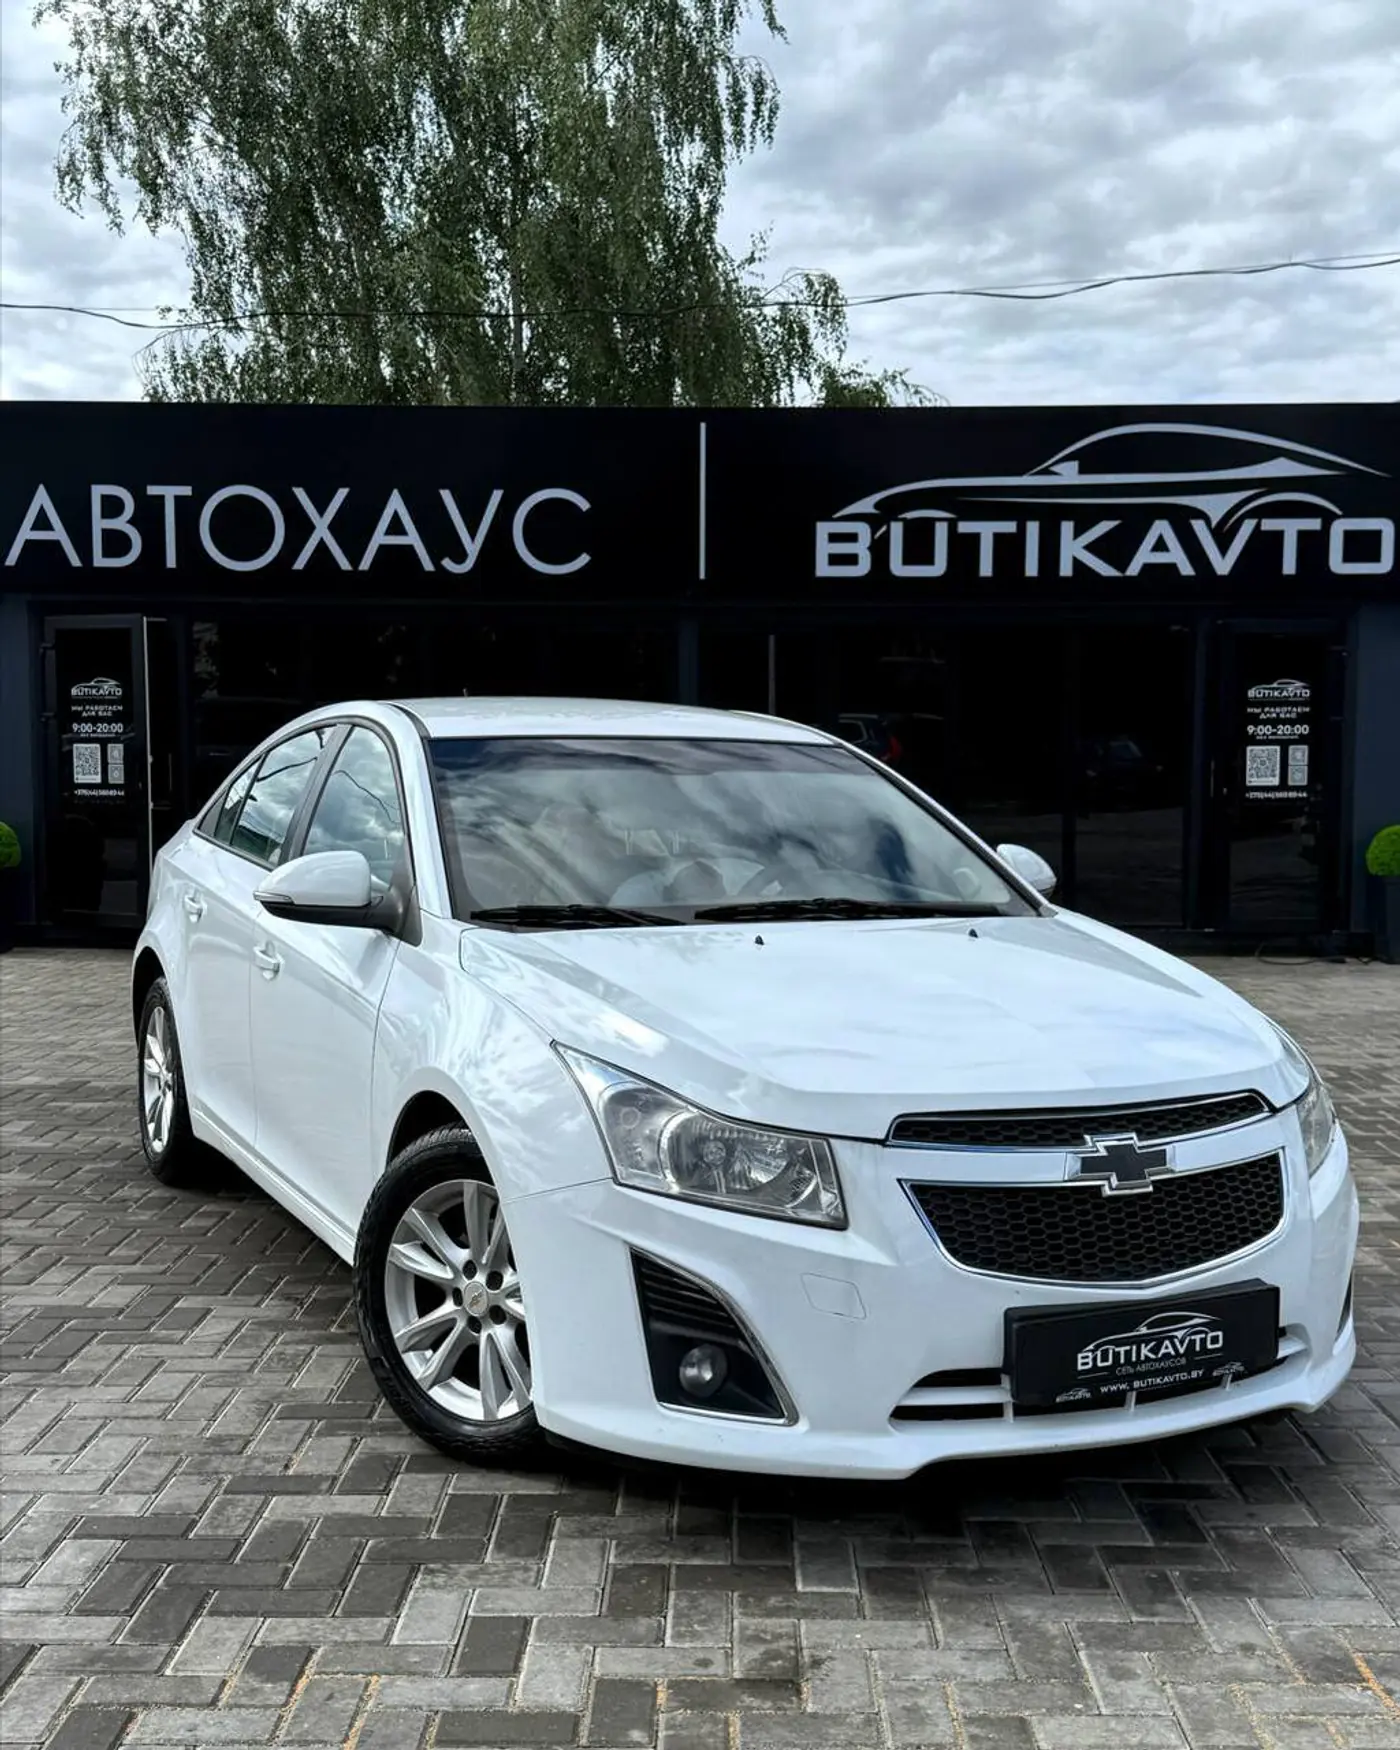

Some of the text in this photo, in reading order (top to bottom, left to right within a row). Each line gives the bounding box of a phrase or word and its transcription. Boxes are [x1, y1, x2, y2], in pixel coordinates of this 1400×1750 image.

[4, 483, 592, 575] АВТОХАУС
[815, 516, 1395, 577] BUTIKAVTO
[71, 686, 122, 696] BUTIKAVTO
[1247, 688, 1310, 698] BUTIKAVTO
[72, 722, 123, 733] 9:00-20:00
[1246, 724, 1310, 735] 9:00-20:00
[1077, 1331, 1224, 1371] BUTIKAVTO
[1133, 1369, 1204, 1389] BUTIKAVTO.BY
